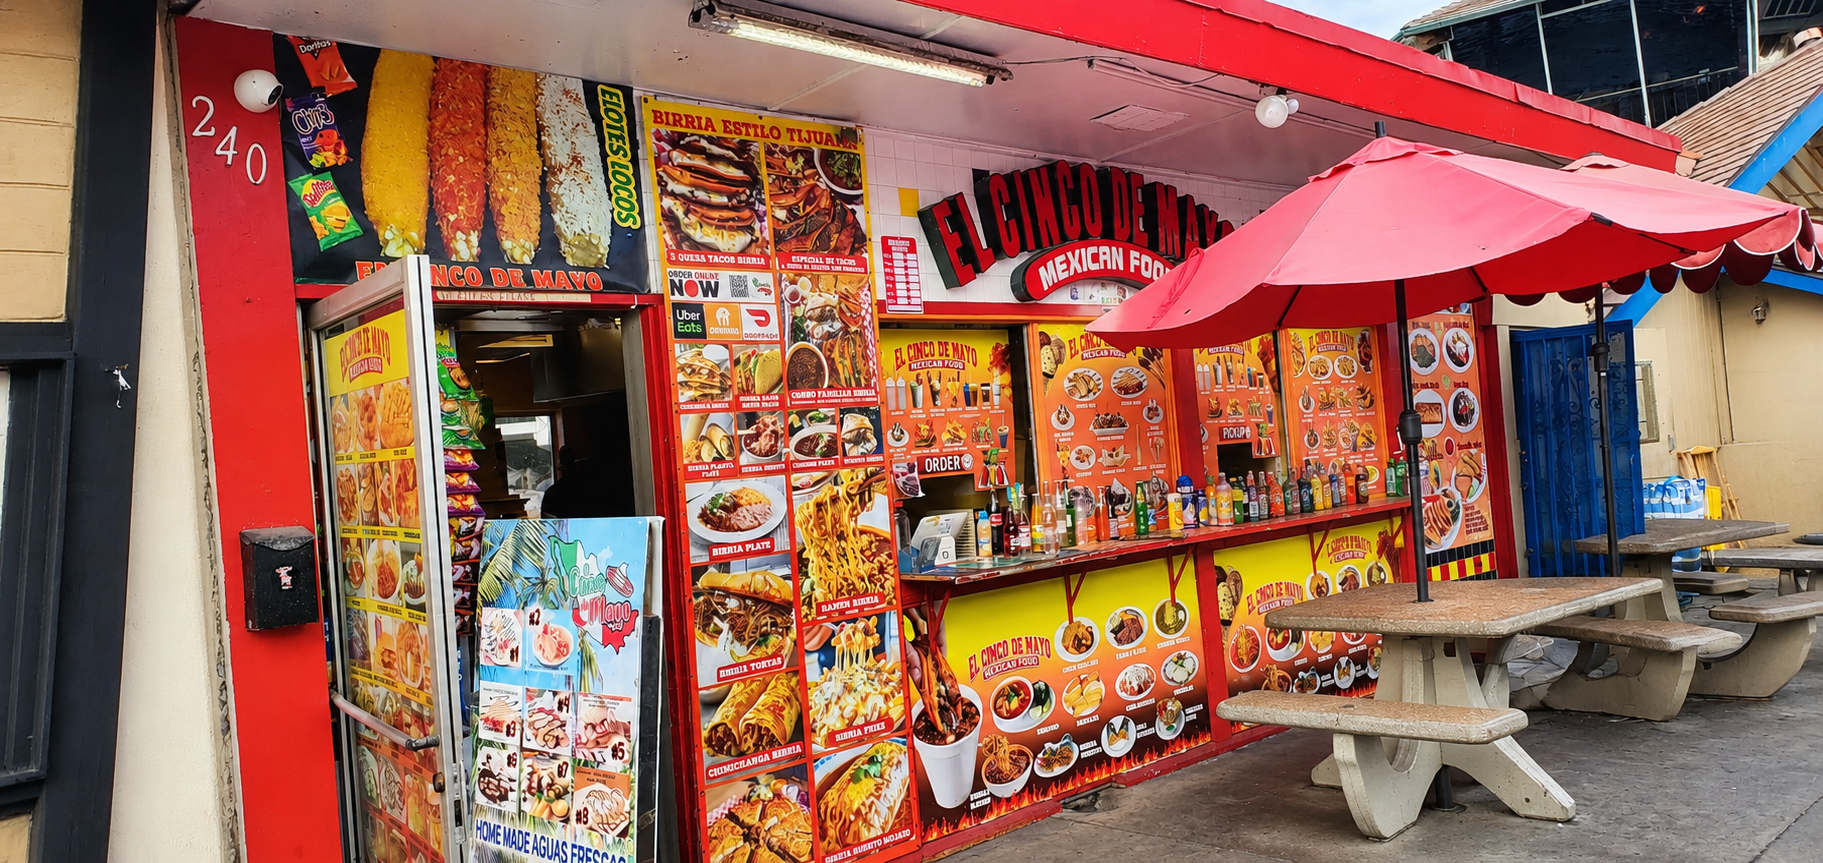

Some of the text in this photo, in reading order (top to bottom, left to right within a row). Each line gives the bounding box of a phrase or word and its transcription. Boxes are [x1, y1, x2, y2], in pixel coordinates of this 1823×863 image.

[652, 109, 717, 132] BIRRIA
[722, 119, 781, 141] ESTILO
[598, 85, 640, 229] ELOTES LOCOS
[927, 192, 997, 288] EL
[982, 160, 1103, 259] CINCO
[1106, 166, 1149, 248] DE
[678, 253, 707, 263] QUESA
[1038, 245, 1172, 291] MEXICAN FOO
[489, 266, 527, 288] DE
[531, 268, 604, 291] MAYO
[668, 270, 693, 279] ORDER
[669, 278, 720, 298] NOW
[676, 308, 701, 321] Uber
[893, 340, 978, 372] EL CINCO DE MAYO
[1068, 337, 1079, 360] EL
[924, 455, 961, 473] ORDER
[712, 541, 771, 556] BIRRIA PLATE
[821, 600, 851, 612] RAMEN
[968, 635, 1051, 683] EL CINCO DE MAYO
[835, 728, 863, 742] BIRRIA
[475, 819, 501, 845] HOME
[503, 825, 530, 855] MADE
[531, 833, 568, 863] AGUAS
